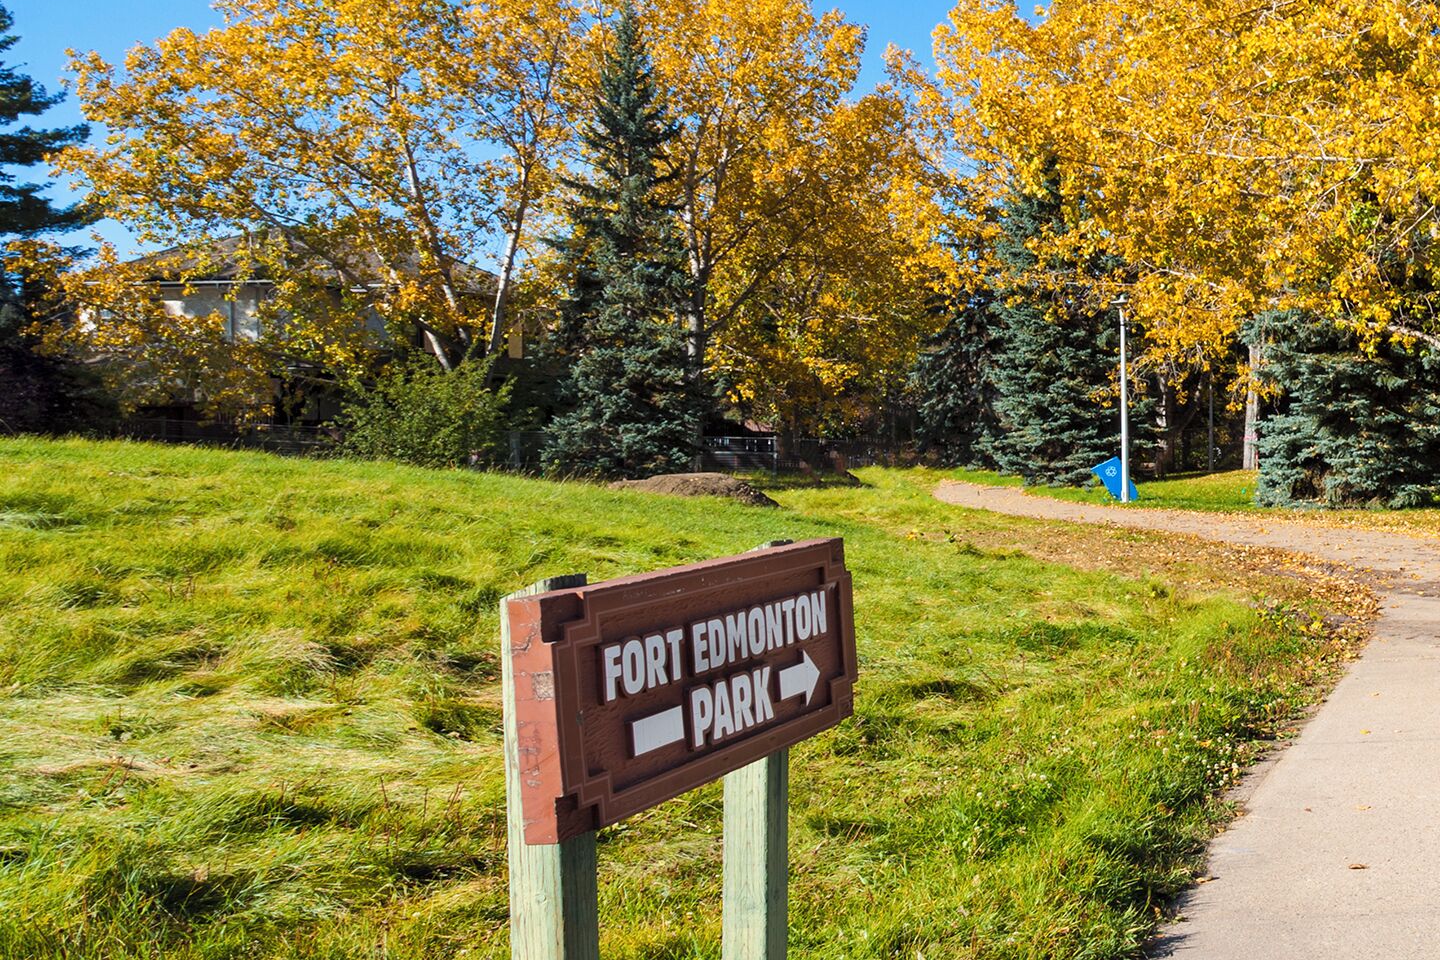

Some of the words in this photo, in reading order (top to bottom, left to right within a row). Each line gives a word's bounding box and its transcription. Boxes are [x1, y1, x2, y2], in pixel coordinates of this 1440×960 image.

[604, 629, 683, 701] FORT
[692, 591, 827, 674] EDMONTON
[691, 667, 774, 747] PARK
